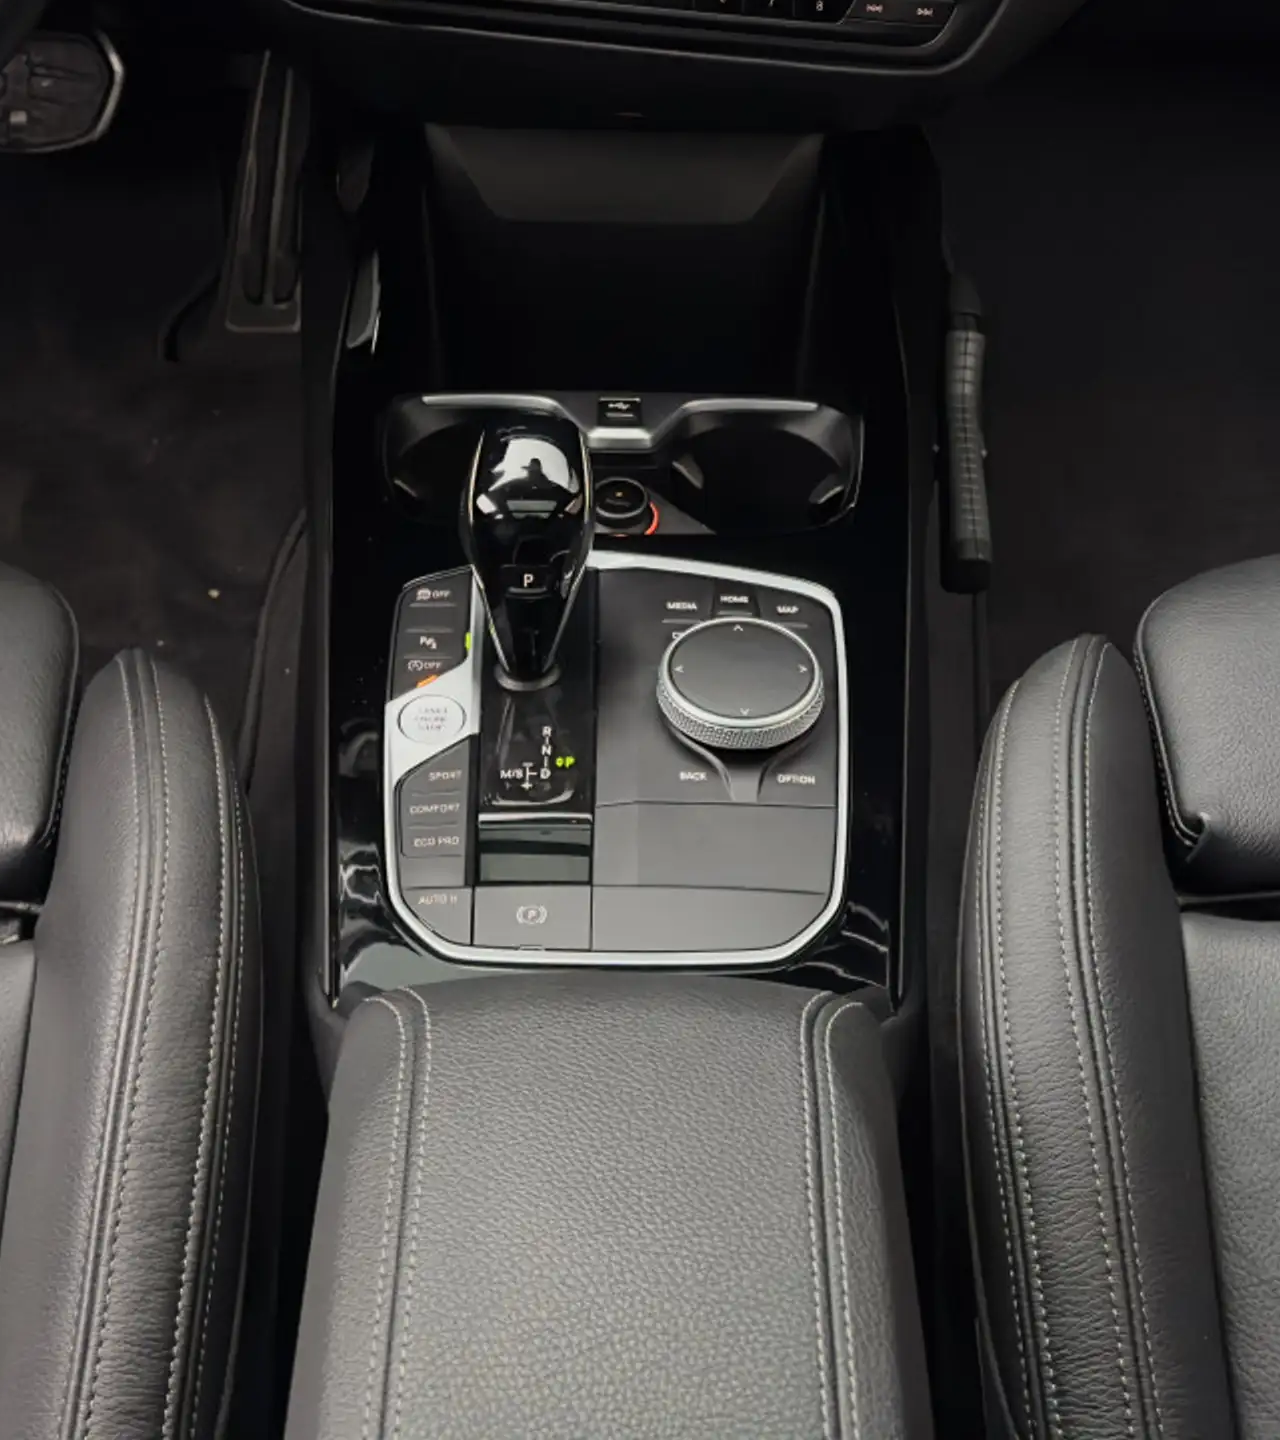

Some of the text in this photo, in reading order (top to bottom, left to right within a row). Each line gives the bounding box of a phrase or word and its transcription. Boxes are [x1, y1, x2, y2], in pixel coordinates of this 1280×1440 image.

[524, 573, 534, 587] P
[720, 595, 749, 604] HOME
[666, 602, 697, 611] MEDIA
[776, 605, 799, 614] MAP
[542, 726, 552, 737] R
[542, 744, 552, 756] N
[428, 770, 462, 781] SPORT
[540, 768, 551, 779] D
[679, 771, 707, 781] BACK
[776, 774, 816, 785] OPTION
[410, 803, 460, 815] COMFORT
[414, 835, 459, 847] ECO PRO
[418, 895, 447, 905] AUTO
